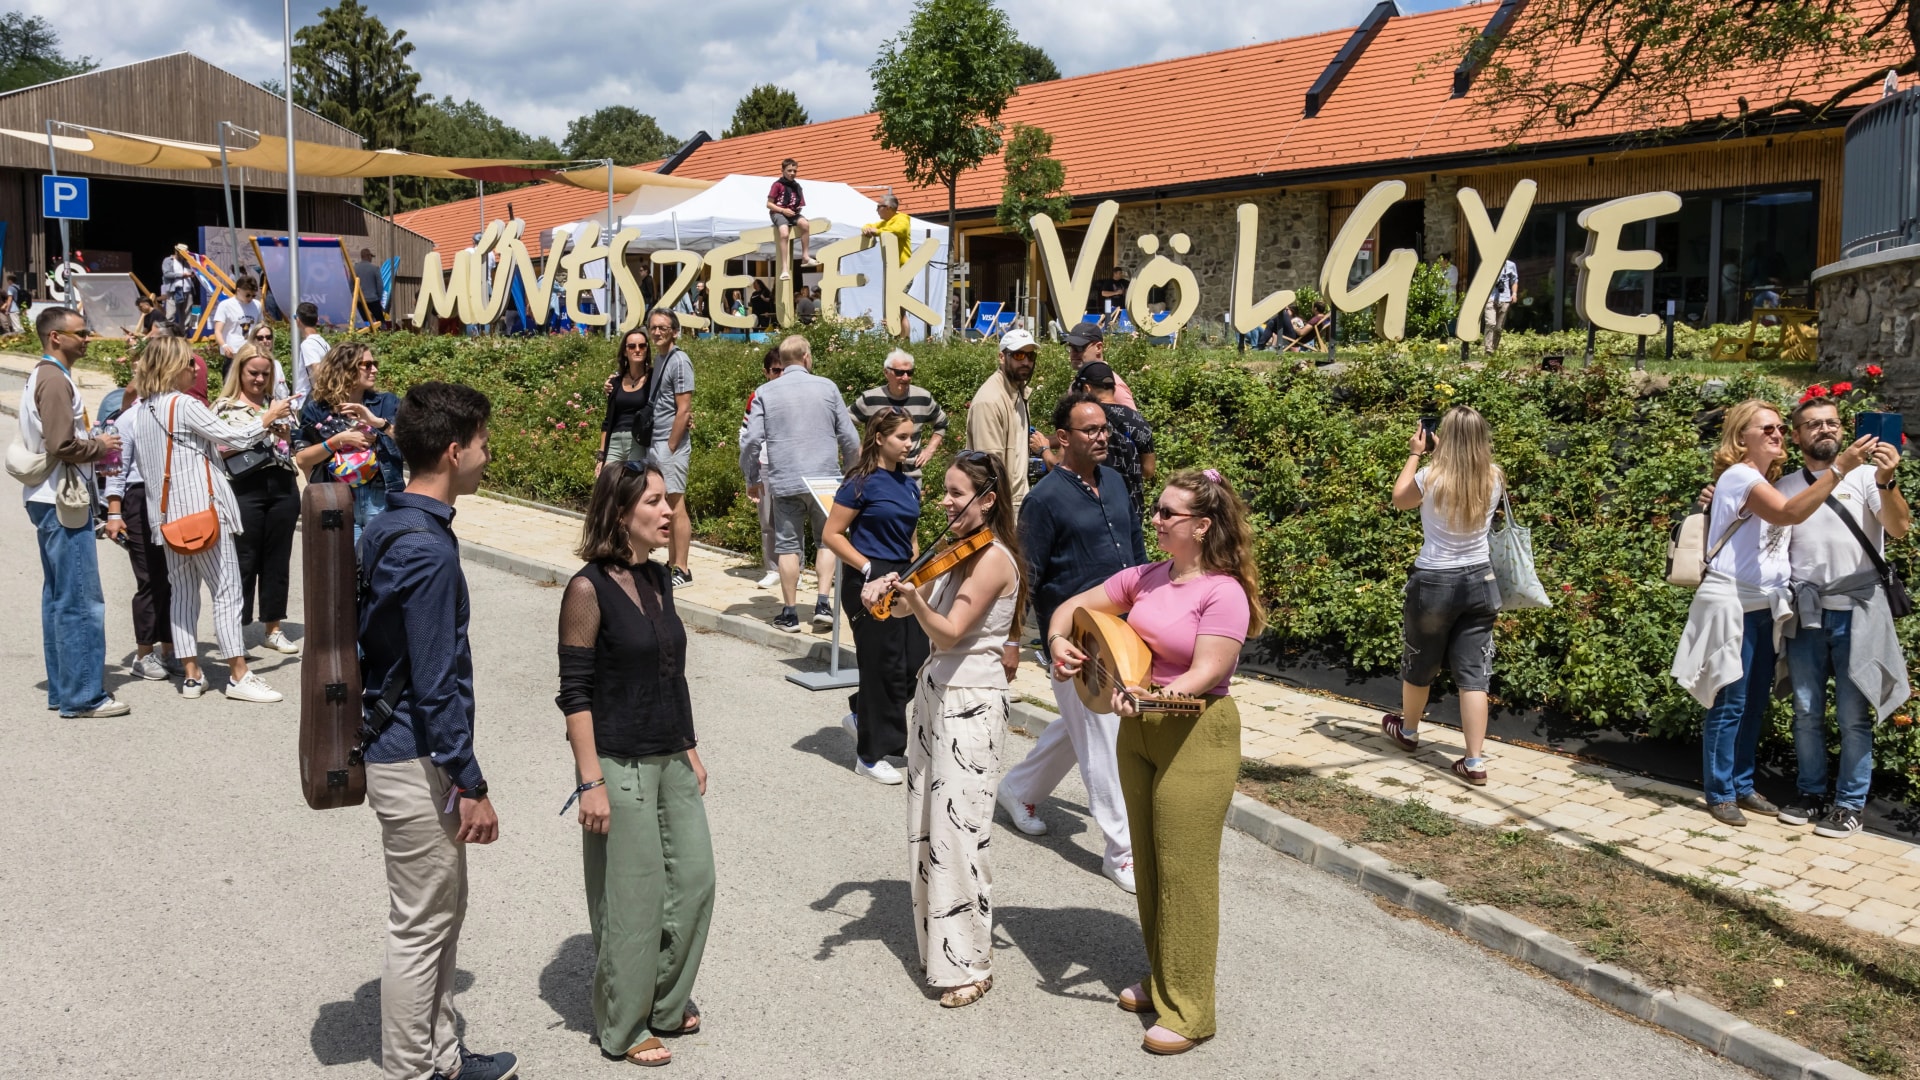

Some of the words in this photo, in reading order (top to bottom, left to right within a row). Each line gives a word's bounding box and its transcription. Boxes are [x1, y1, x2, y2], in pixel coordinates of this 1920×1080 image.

[54, 182, 78, 212] P
[411, 217, 942, 337] MŰVÉSZETEK
[1030, 178, 1682, 342] VÖLGYE
